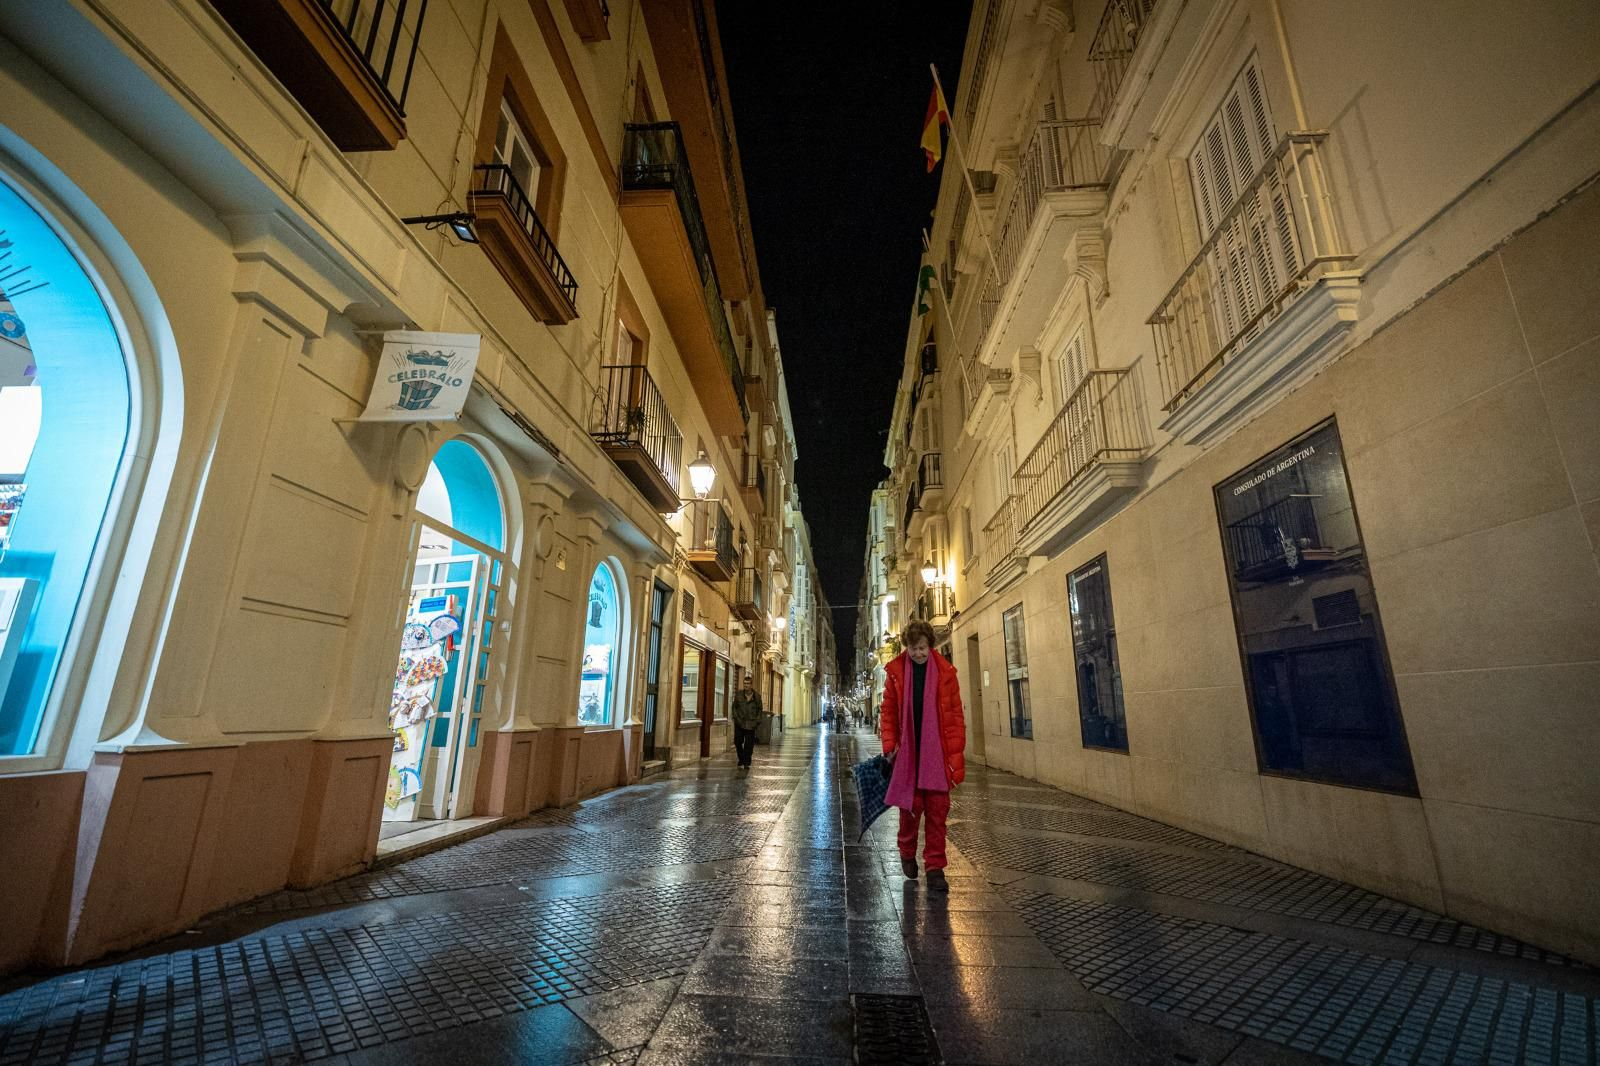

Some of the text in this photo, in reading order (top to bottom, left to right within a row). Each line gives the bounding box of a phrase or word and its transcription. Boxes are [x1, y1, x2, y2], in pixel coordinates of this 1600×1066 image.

[1233, 445, 1315, 496] CONSULADO DE ARGENTINA
